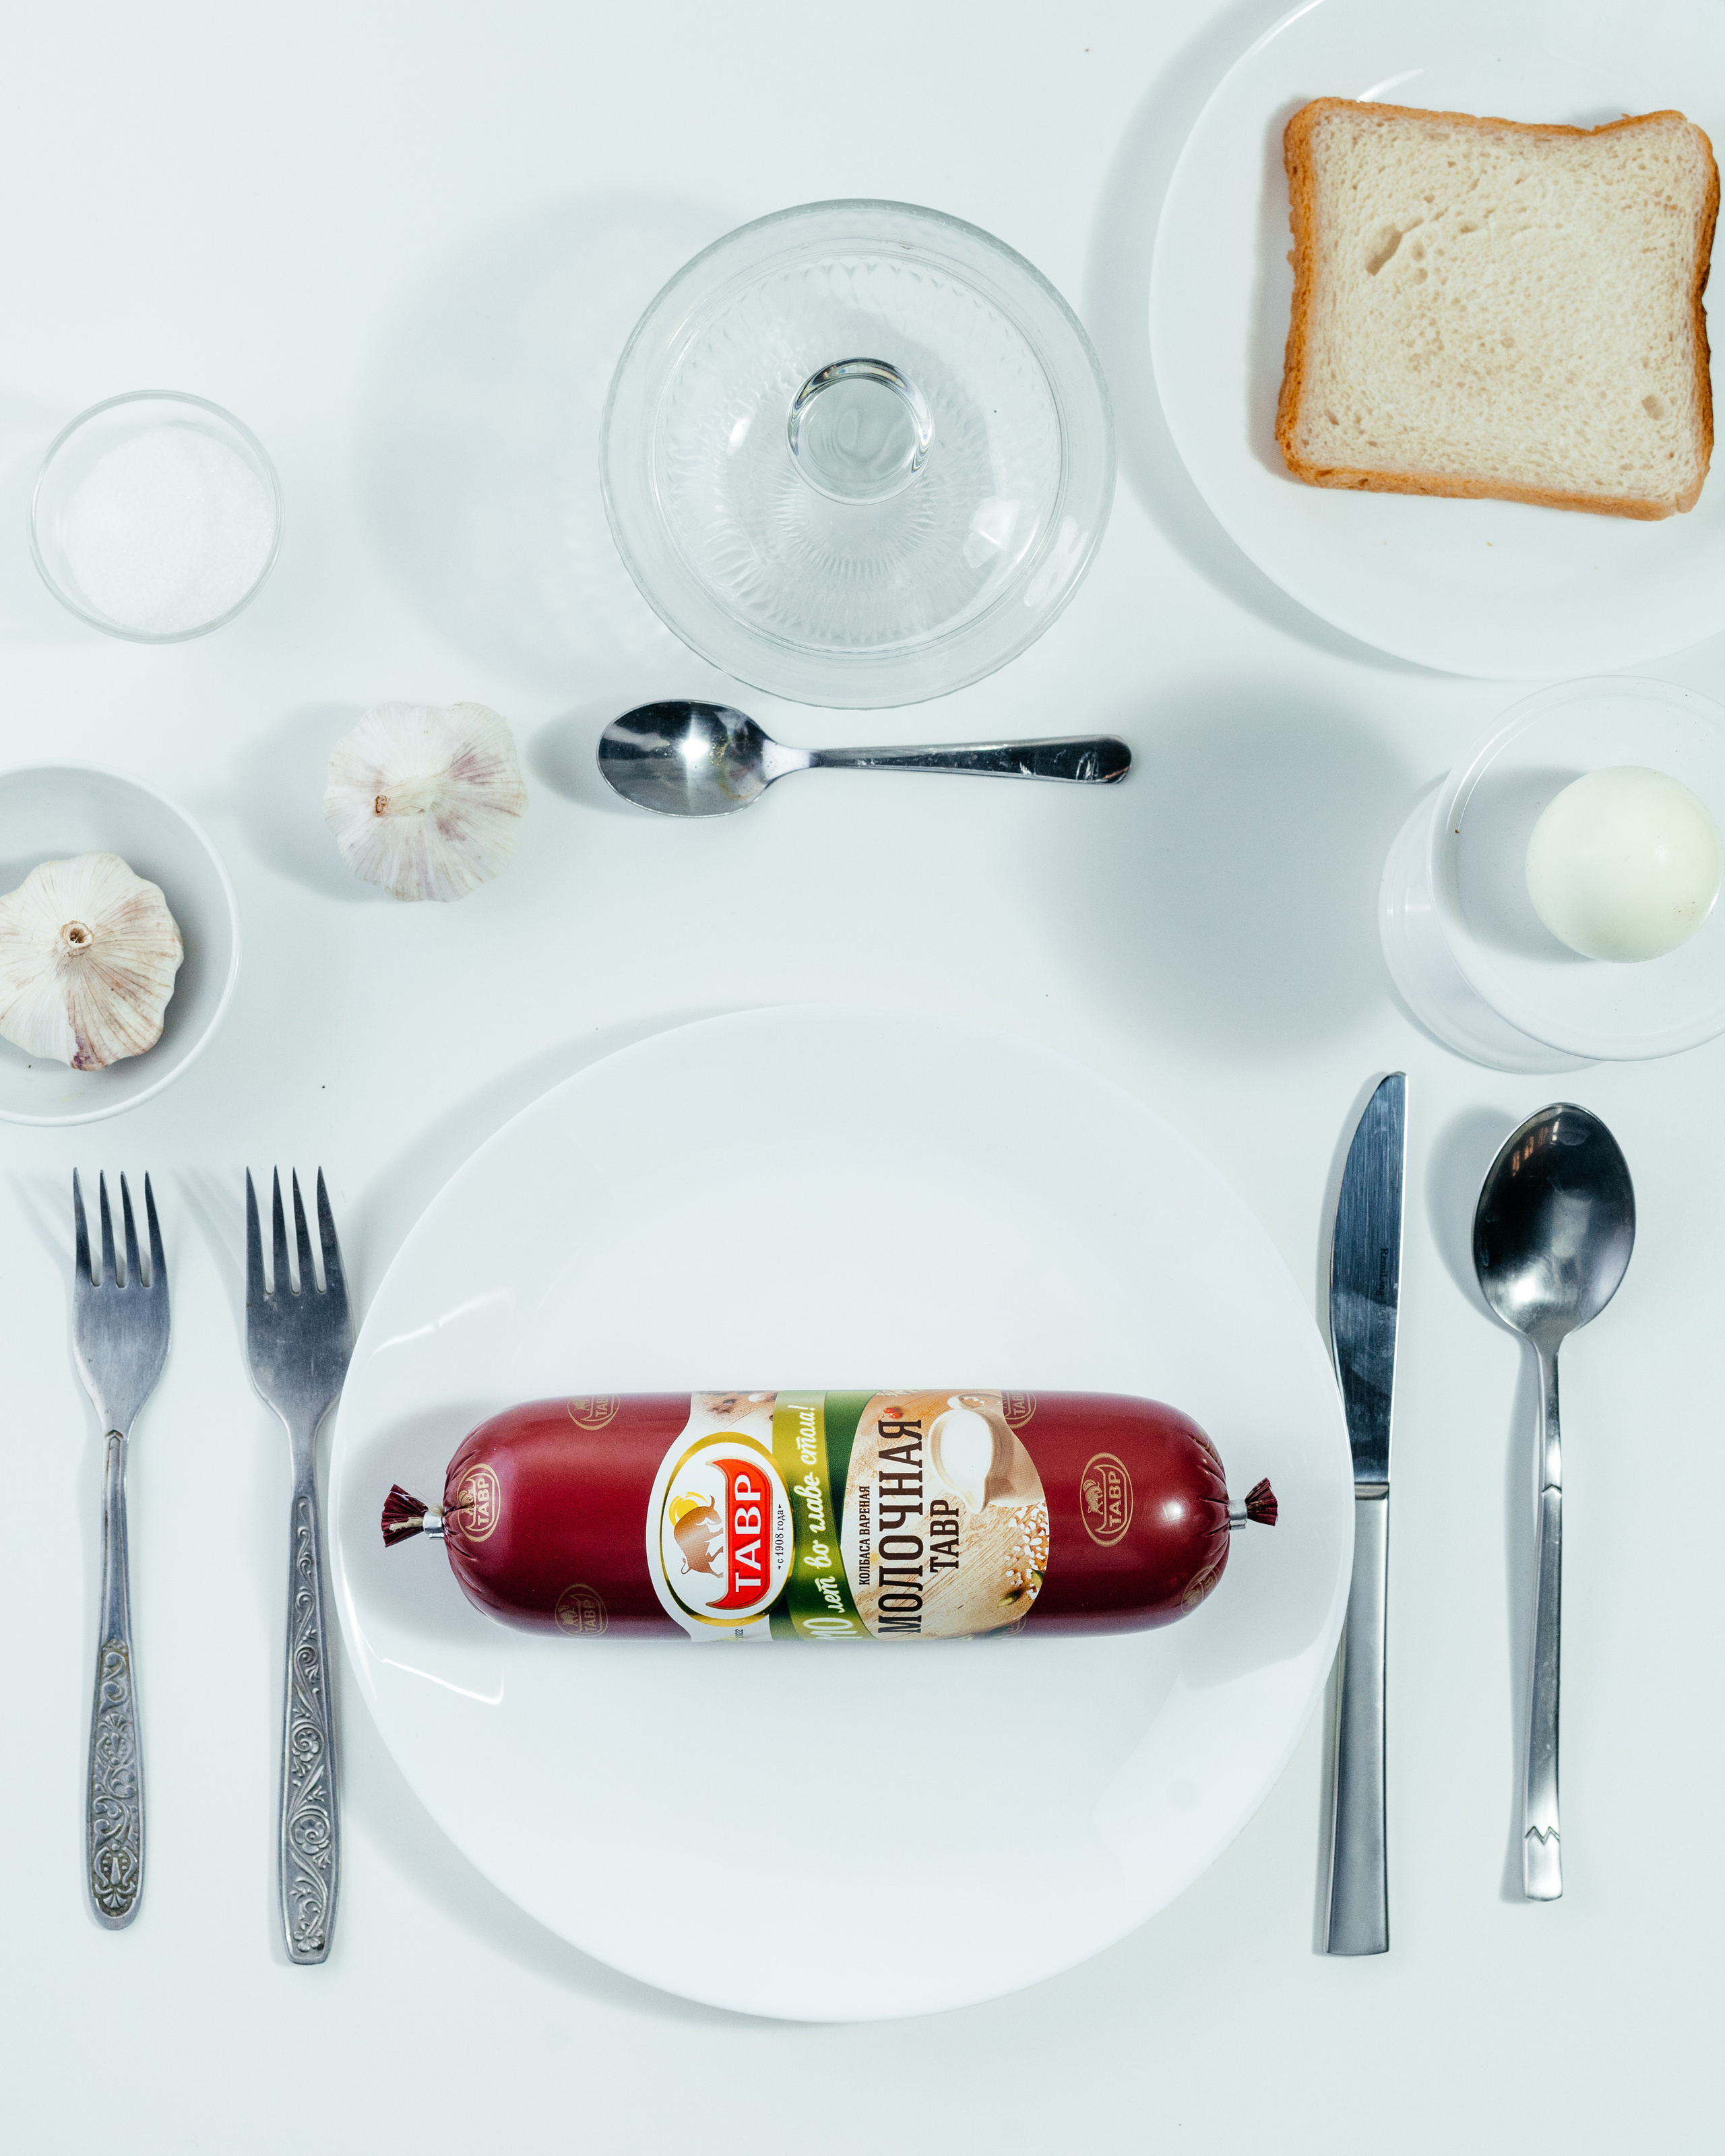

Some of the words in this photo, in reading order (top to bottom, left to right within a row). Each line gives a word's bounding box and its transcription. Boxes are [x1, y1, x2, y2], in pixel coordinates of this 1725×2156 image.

[787, 1405, 817, 1465] стола!
[478, 1478, 489, 1526] ТАВР
[778, 1509, 786, 1531] года
[793, 1471, 826, 1533] главе
[858, 1486, 870, 1535] ВАРЕНАЯ
[1108, 1471, 1121, 1527] ТАВР
[734, 1474, 761, 1593] ТАВР
[775, 1533, 784, 1556] 1908
[877, 1420, 923, 1633] МОЛОЧНАЯ
[929, 1499, 960, 1573] ТАВР
[803, 1540, 832, 1569] во
[859, 1537, 870, 1585] КОЛБАСА
[582, 1599, 597, 1632] ТАВР
[815, 1576, 845, 1613] лет
